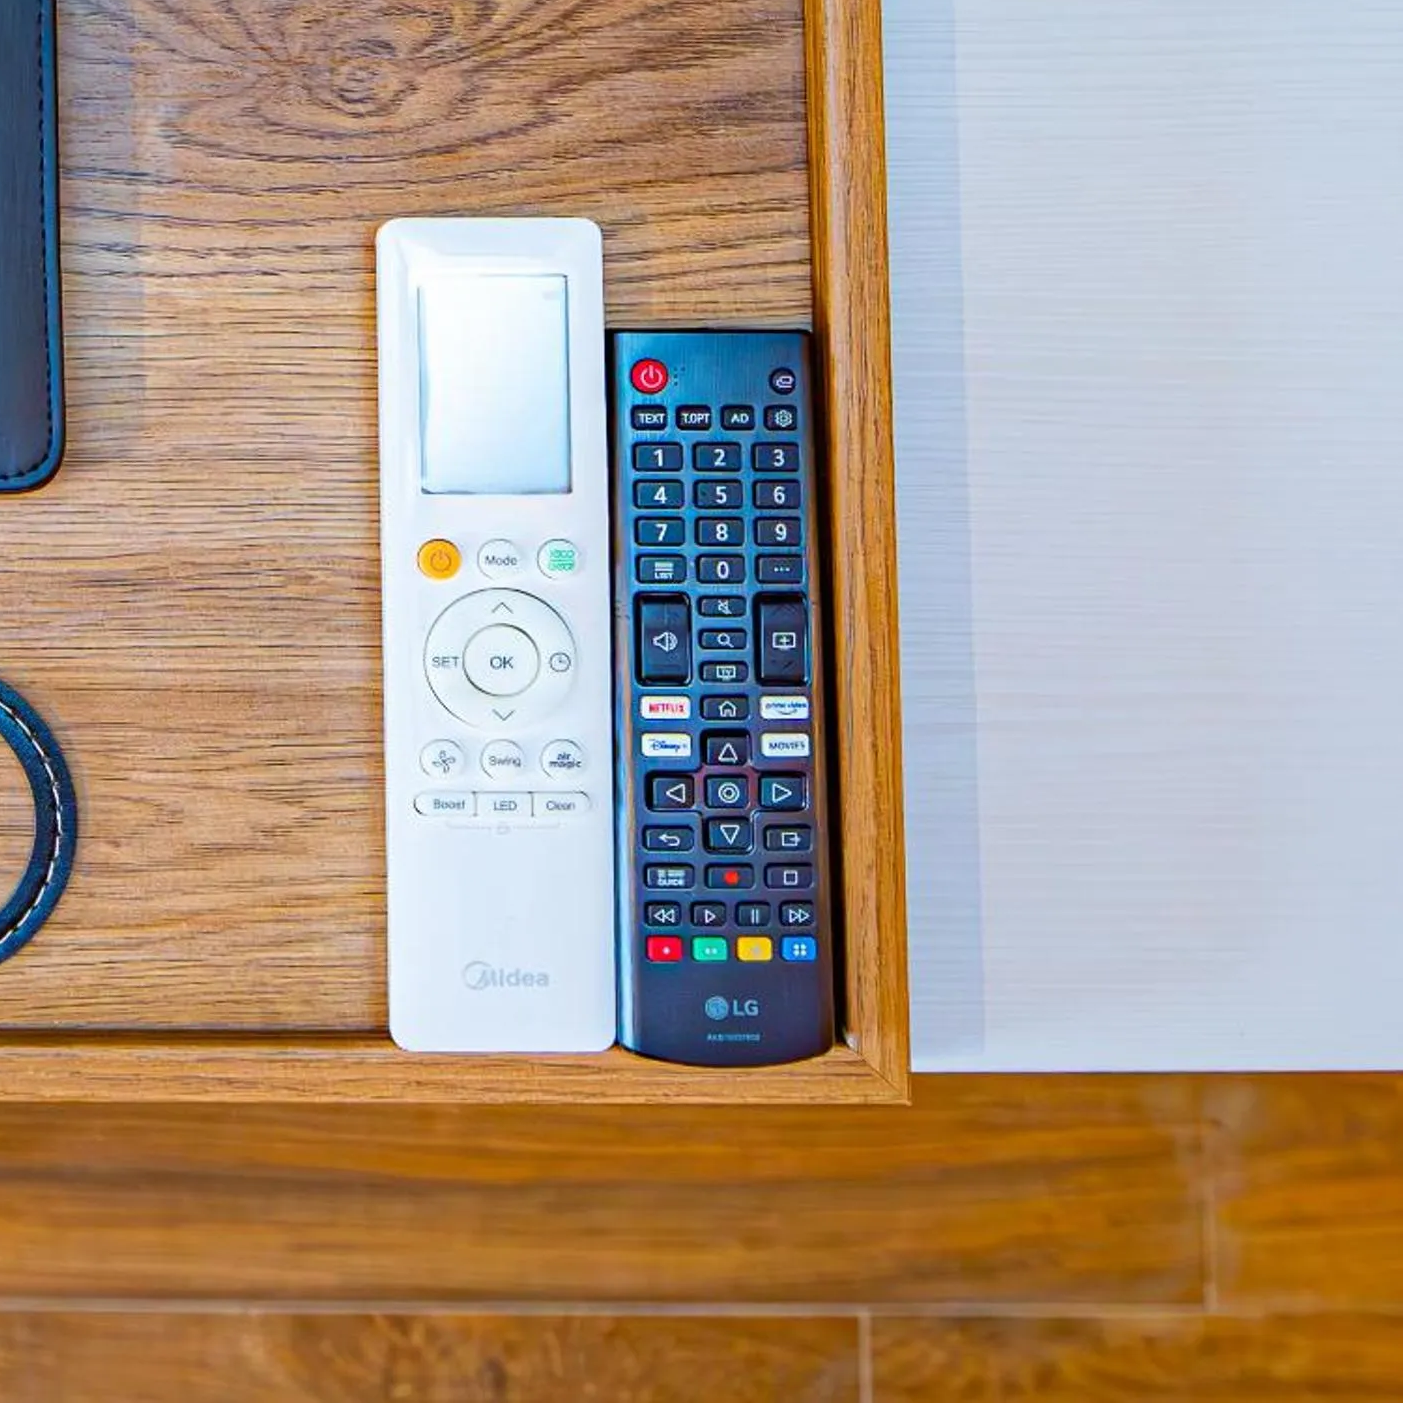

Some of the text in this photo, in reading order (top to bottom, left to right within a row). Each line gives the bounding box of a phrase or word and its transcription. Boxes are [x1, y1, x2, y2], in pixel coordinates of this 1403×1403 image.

[639, 413, 665, 423] TEXT
[731, 413, 749, 423] AD
[654, 449, 664, 467] 1
[714, 449, 726, 466] 2
[773, 449, 785, 466] 3
[654, 486, 667, 504] 4
[715, 486, 727, 504] 5
[773, 486, 785, 504] 6
[655, 523, 668, 541] 7
[716, 524, 728, 541] 8
[775, 523, 787, 541] 9
[485, 554, 517, 566] Mode
[717, 561, 728, 578] 0
[432, 657, 459, 668] SET
[490, 656, 514, 669] OK
[649, 703, 684, 713] NETFLIX
[768, 741, 805, 750] MOVIES
[488, 755, 521, 769] Swing
[557, 752, 571, 761] air
[550, 759, 581, 769] magic
[433, 799, 466, 810] Boost
[493, 801, 517, 811] LED
[546, 800, 576, 811] Clean
[461, 960, 549, 990] Midea
[733, 1000, 758, 1016] LG
